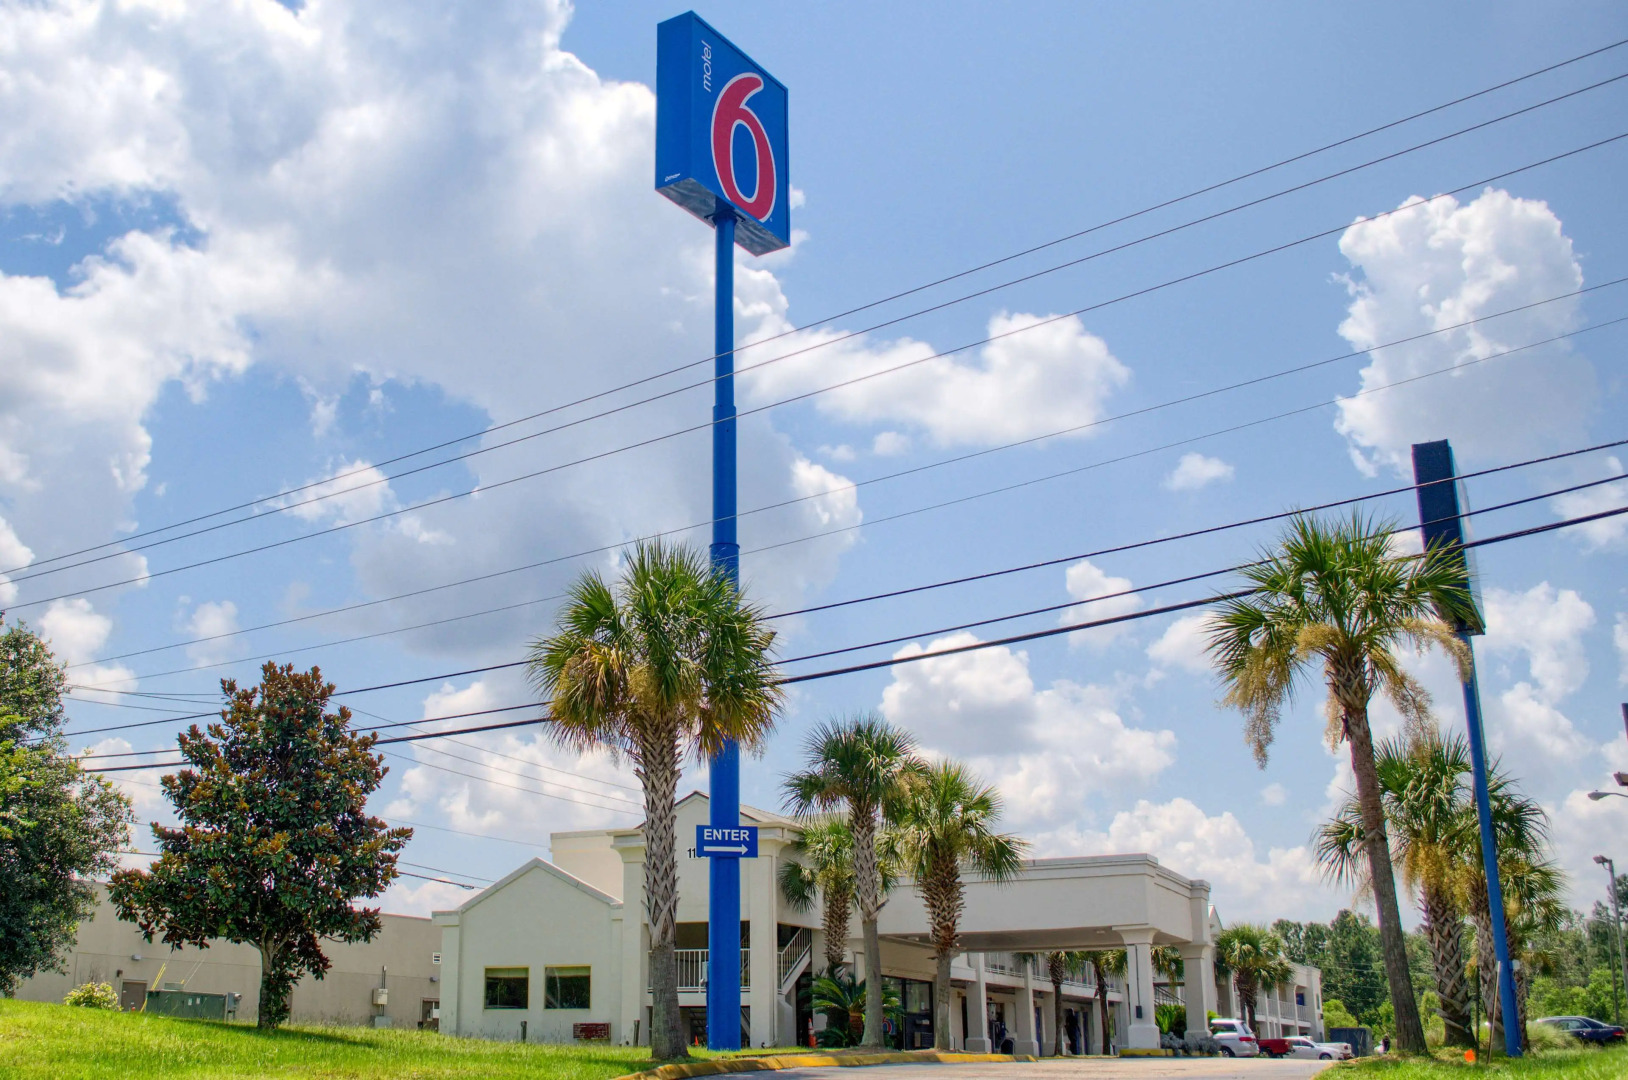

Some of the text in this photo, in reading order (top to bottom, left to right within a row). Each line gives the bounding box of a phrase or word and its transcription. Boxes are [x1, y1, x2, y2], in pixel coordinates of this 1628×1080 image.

[701, 40, 712, 93] motel
[711, 72, 777, 223] 6
[703, 828, 750, 841] ENTER
